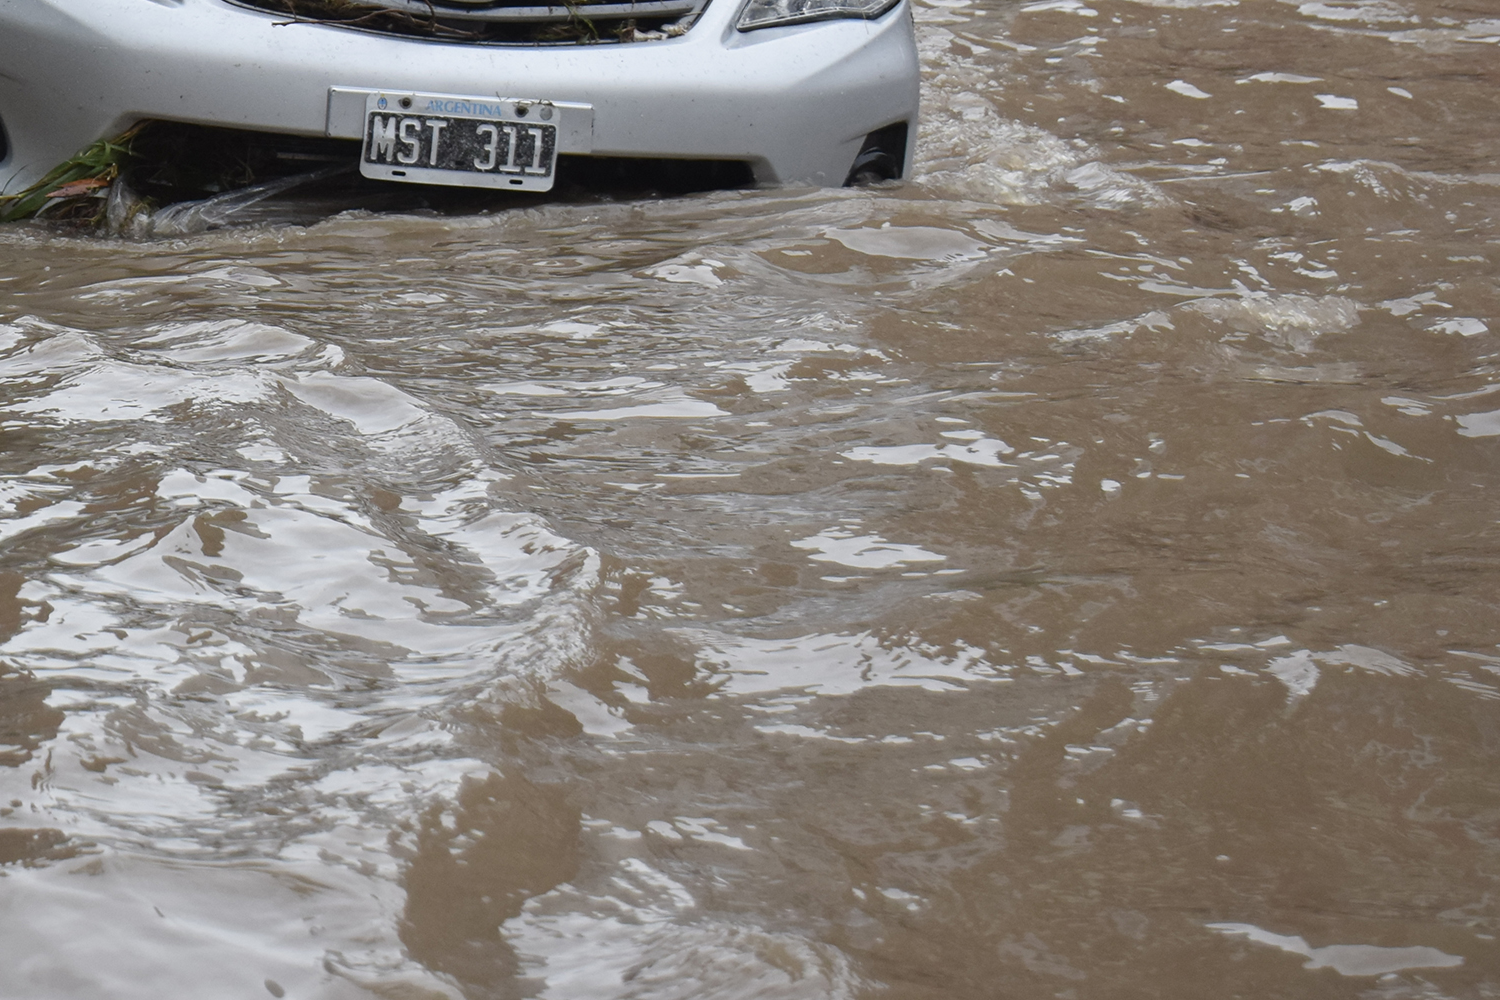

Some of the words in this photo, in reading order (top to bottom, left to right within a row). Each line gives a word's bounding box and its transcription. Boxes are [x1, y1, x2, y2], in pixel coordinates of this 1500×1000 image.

[426, 99, 502, 117] ARGENTINA
[370, 115, 448, 166] MST
[473, 123, 547, 175] 311
